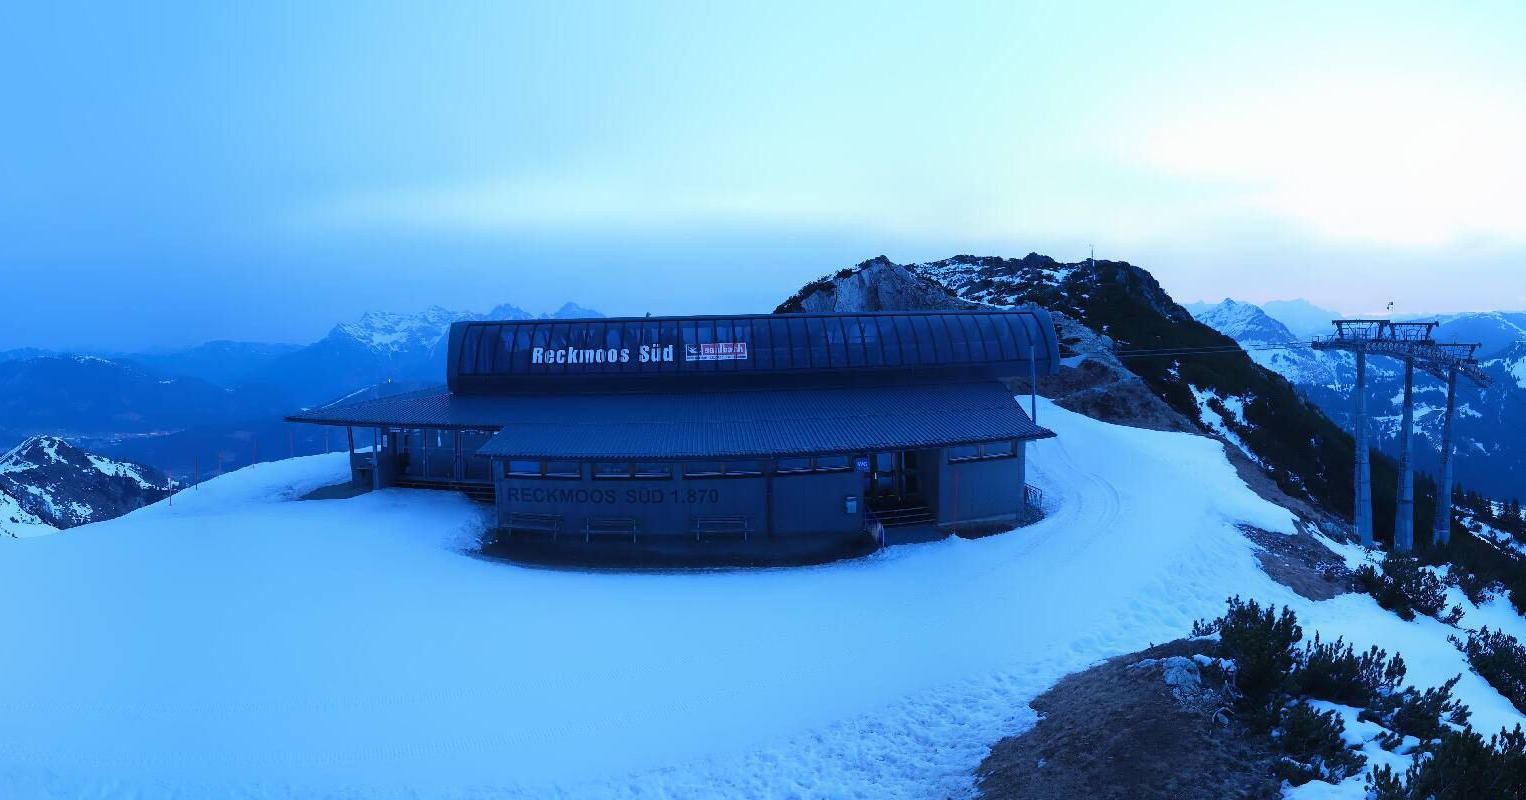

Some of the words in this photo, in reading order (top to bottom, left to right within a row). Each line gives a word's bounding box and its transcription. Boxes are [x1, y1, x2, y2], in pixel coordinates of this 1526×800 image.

[531, 346, 630, 363] Reckmoos
[638, 343, 674, 362] Süd
[507, 487, 616, 504] RECKMOOS
[670, 488, 719, 504] 1.870
